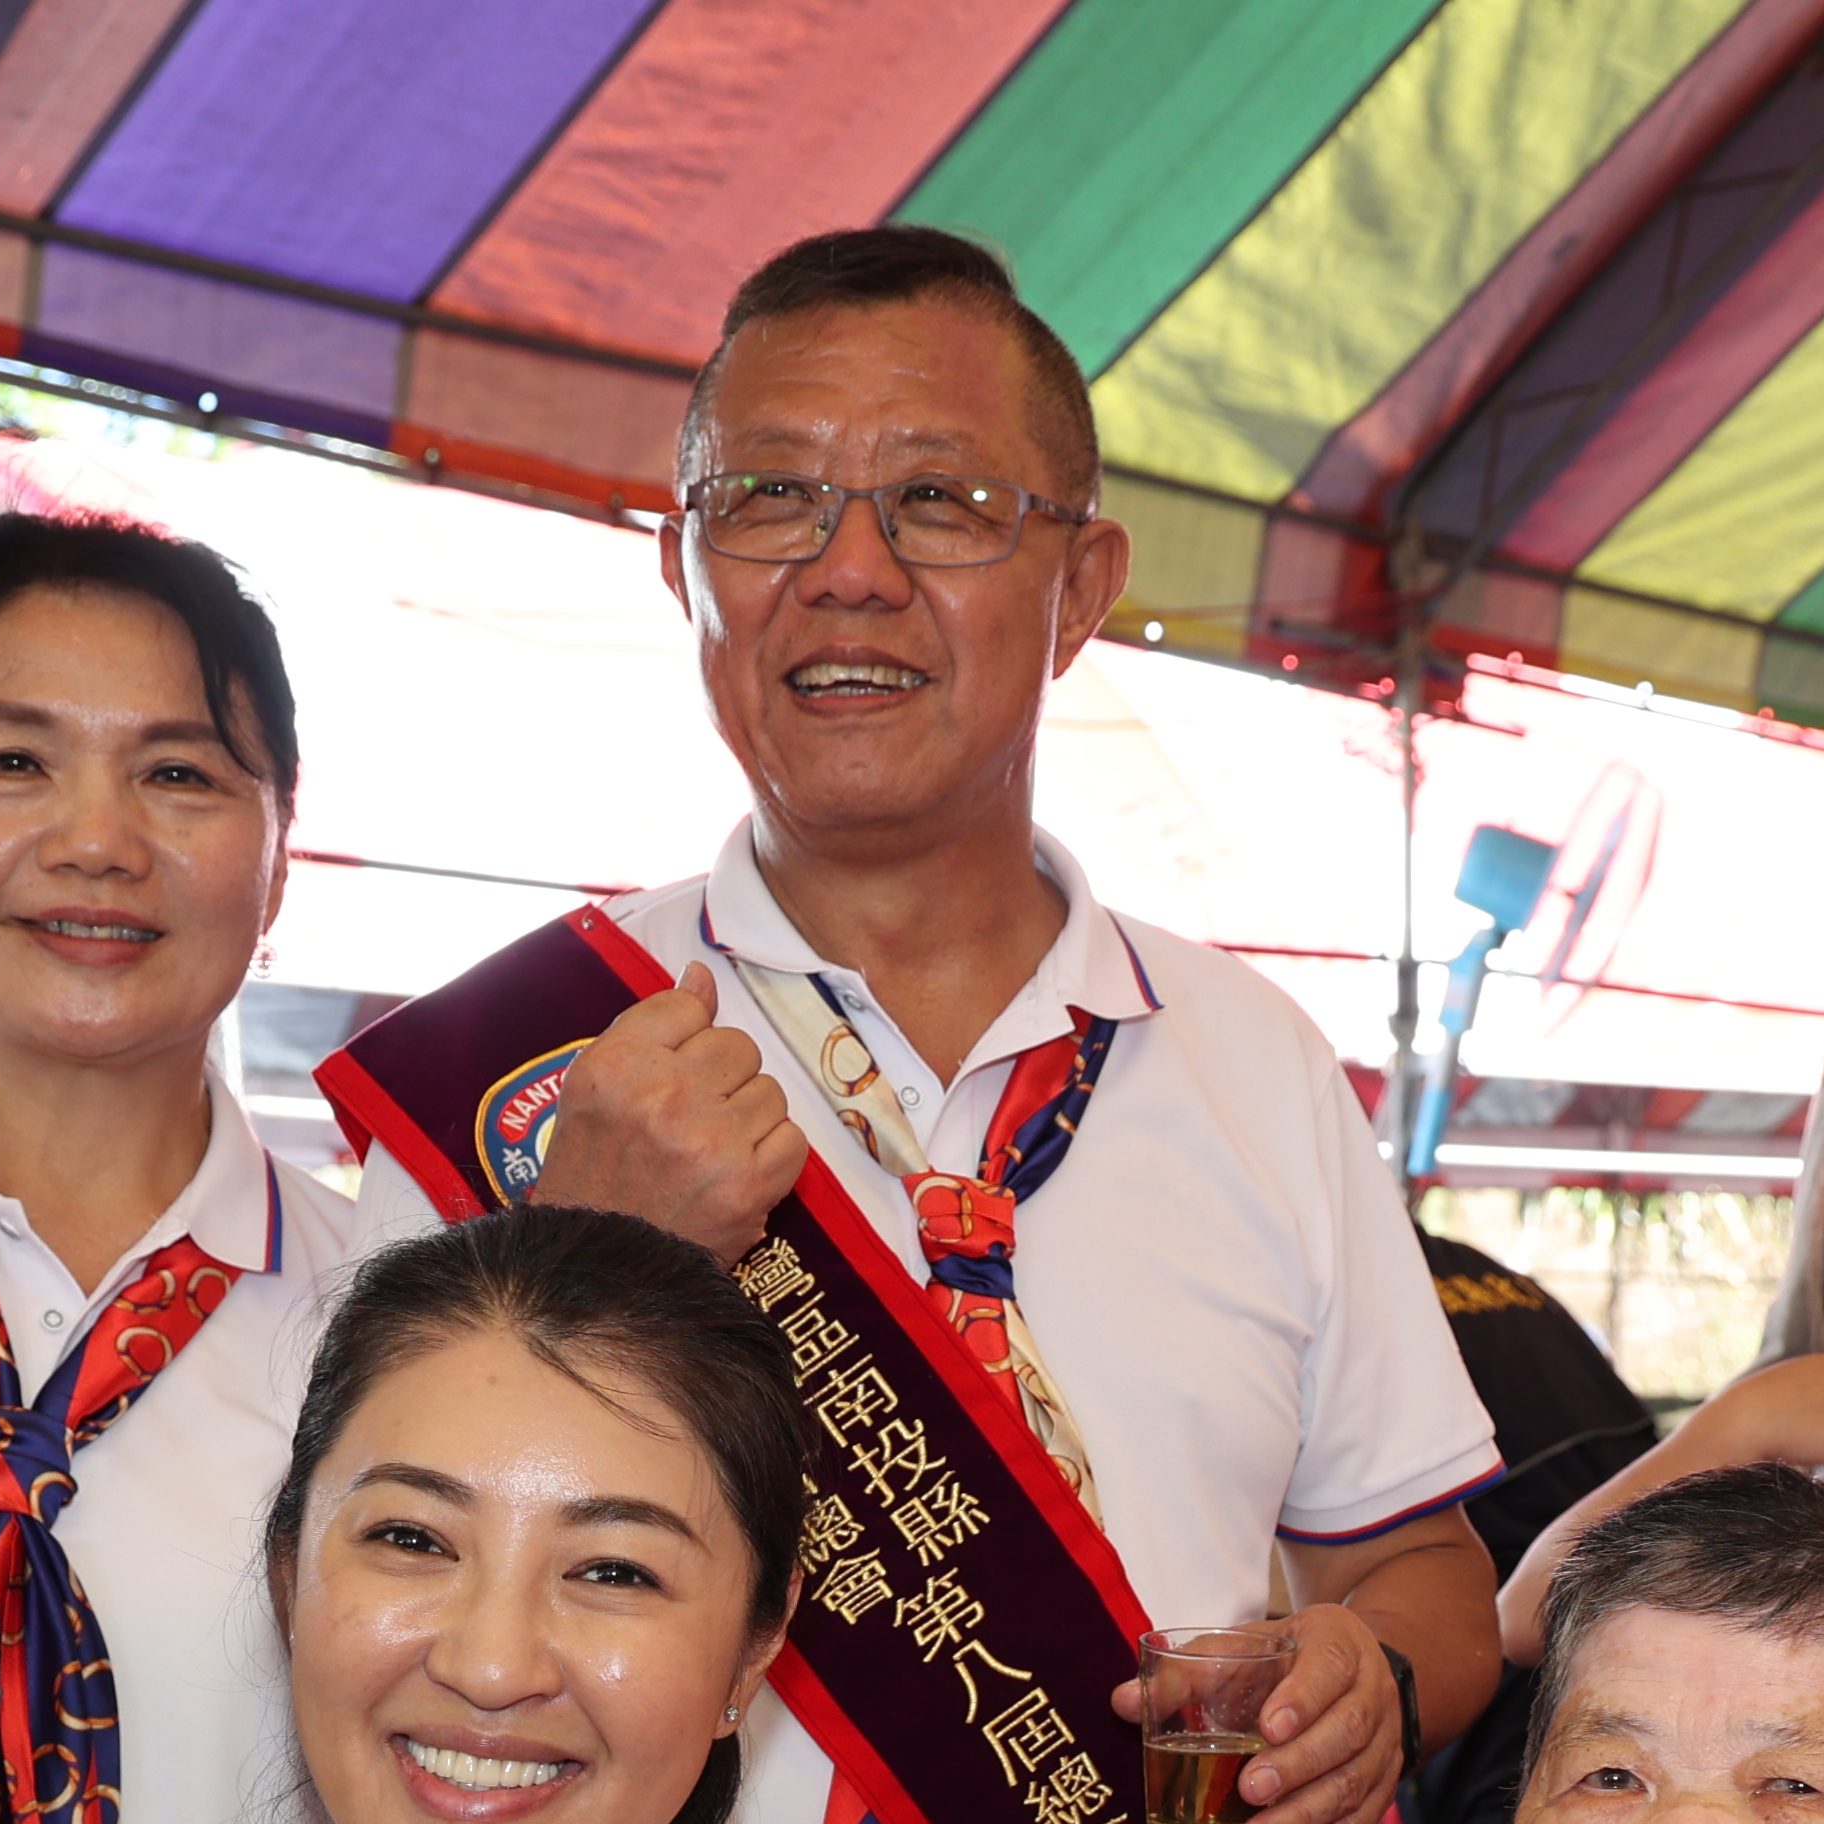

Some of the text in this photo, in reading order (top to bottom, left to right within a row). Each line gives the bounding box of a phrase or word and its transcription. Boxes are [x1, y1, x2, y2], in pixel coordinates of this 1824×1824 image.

[501, 1071, 567, 1131] NANT
[501, 1147, 538, 1185] 南
[797, 1472, 894, 1625] 總會
